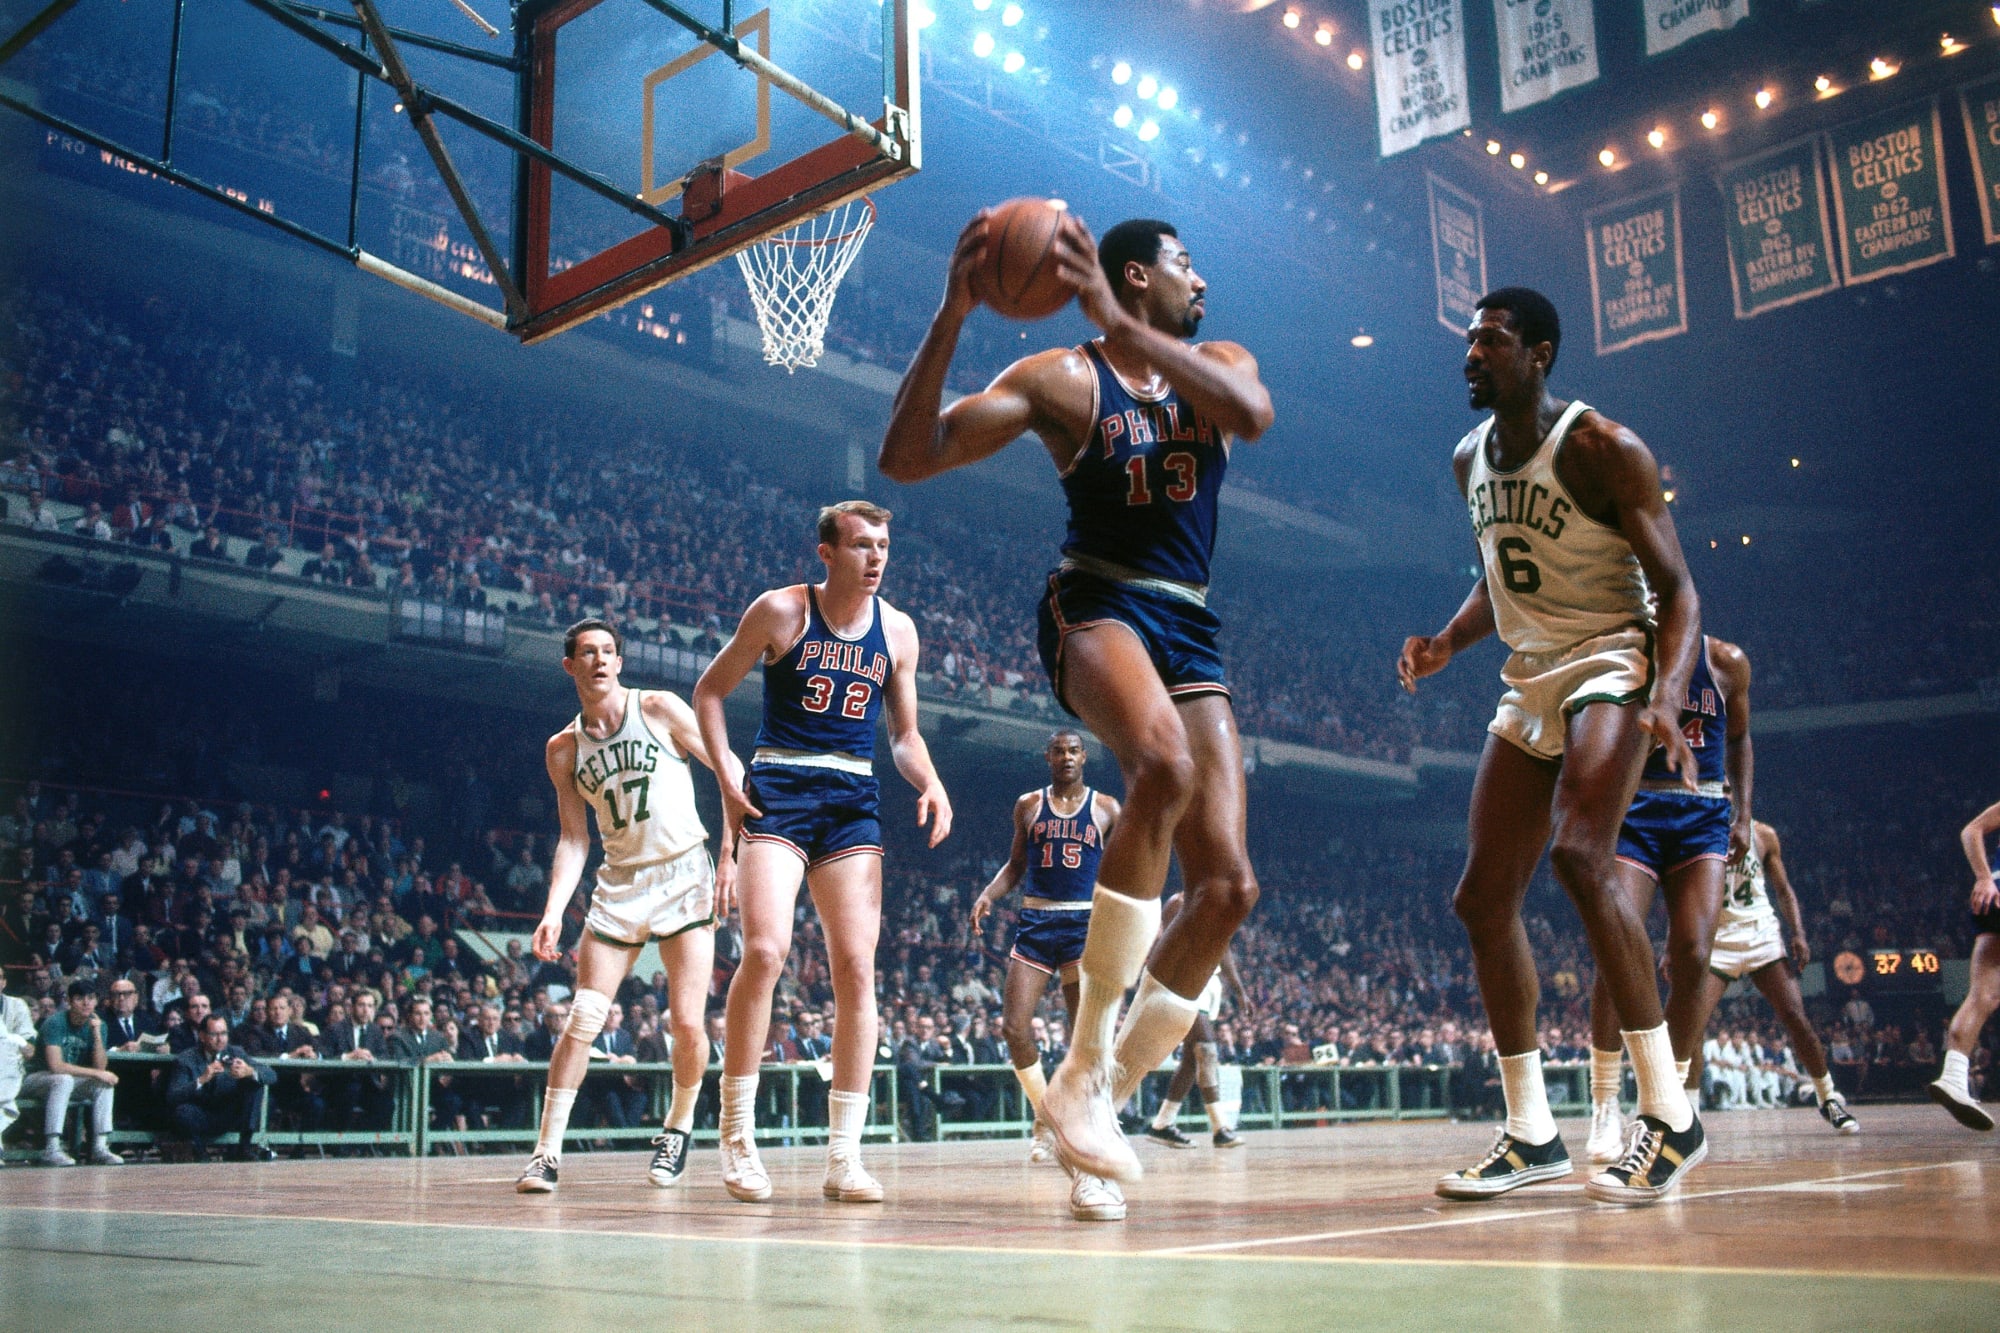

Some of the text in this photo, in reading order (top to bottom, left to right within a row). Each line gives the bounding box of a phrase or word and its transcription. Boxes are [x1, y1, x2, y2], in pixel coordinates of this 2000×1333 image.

[1381, 0, 1451, 32] BOSTO
[1384, 8, 1452, 57] CELTICS
[47, 132, 86, 155] PRO
[1849, 125, 1921, 168] BOSTON
[1735, 165, 1800, 204] BOSTON
[1852, 148, 1923, 190] CELTICS
[1738, 187, 1802, 227] CELTICS
[1873, 196, 1910, 220] 1962
[1602, 209, 1665, 247] BOSTON
[1855, 214, 1908, 244] EASTERN
[1861, 224, 1931, 259] CHAMPIONS
[1604, 233, 1666, 269] CELTICS
[1100, 402, 1214, 461] PHILA
[1125, 451, 1197, 506] 13
[1469, 479, 1571, 540] CELTICS
[1497, 536, 1542, 593] 6
[795, 640, 888, 688] PHILA
[801, 674, 872, 720] 32
[577, 740, 659, 795] CELTICS
[604, 775, 651, 830] 17
[1034, 819, 1097, 848] PHILA
[1041, 842, 1082, 869] 15
[1874, 952, 1940, 975] 37 40
